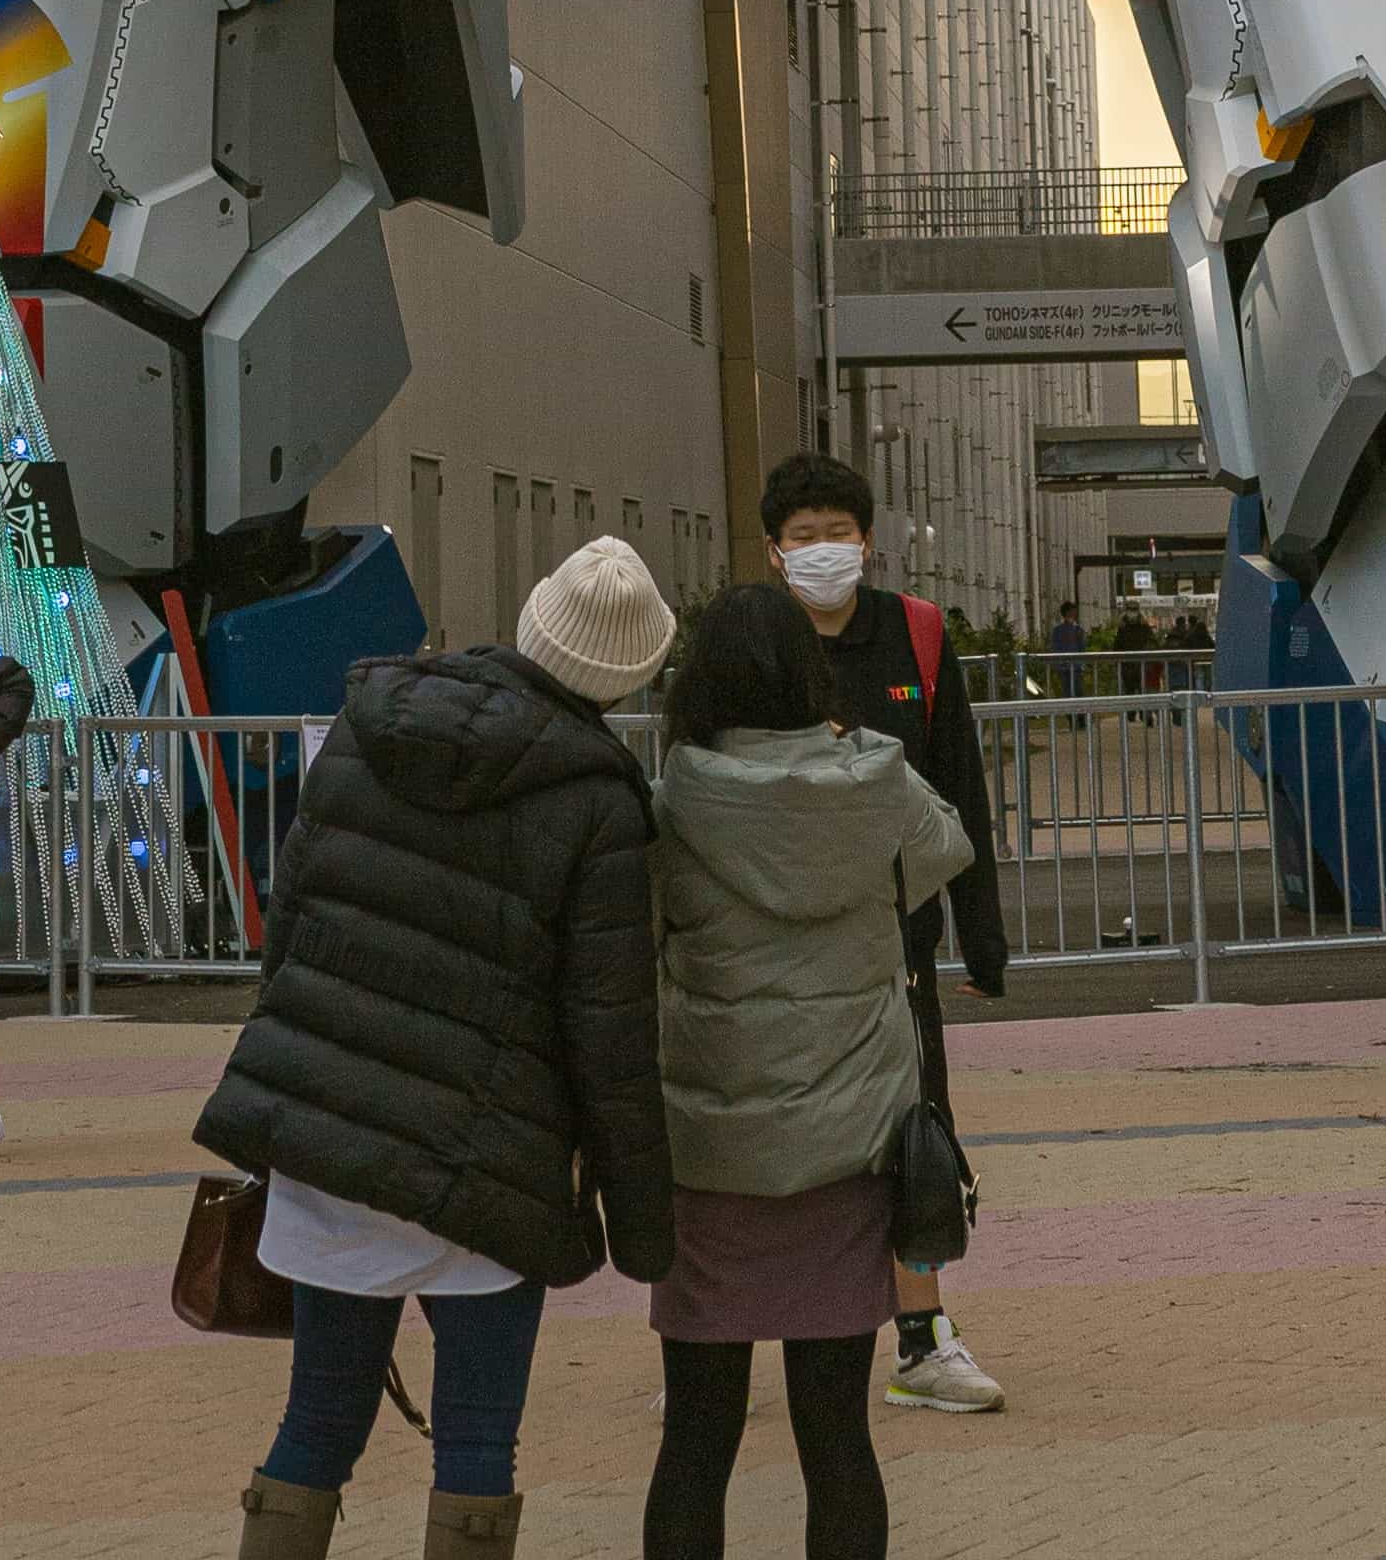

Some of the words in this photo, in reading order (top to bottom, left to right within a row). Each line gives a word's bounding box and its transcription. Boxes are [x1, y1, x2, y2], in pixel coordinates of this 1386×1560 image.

[1092, 303, 1180, 319] クリニックモール(
[984, 325, 1027, 341] GUNDAM
